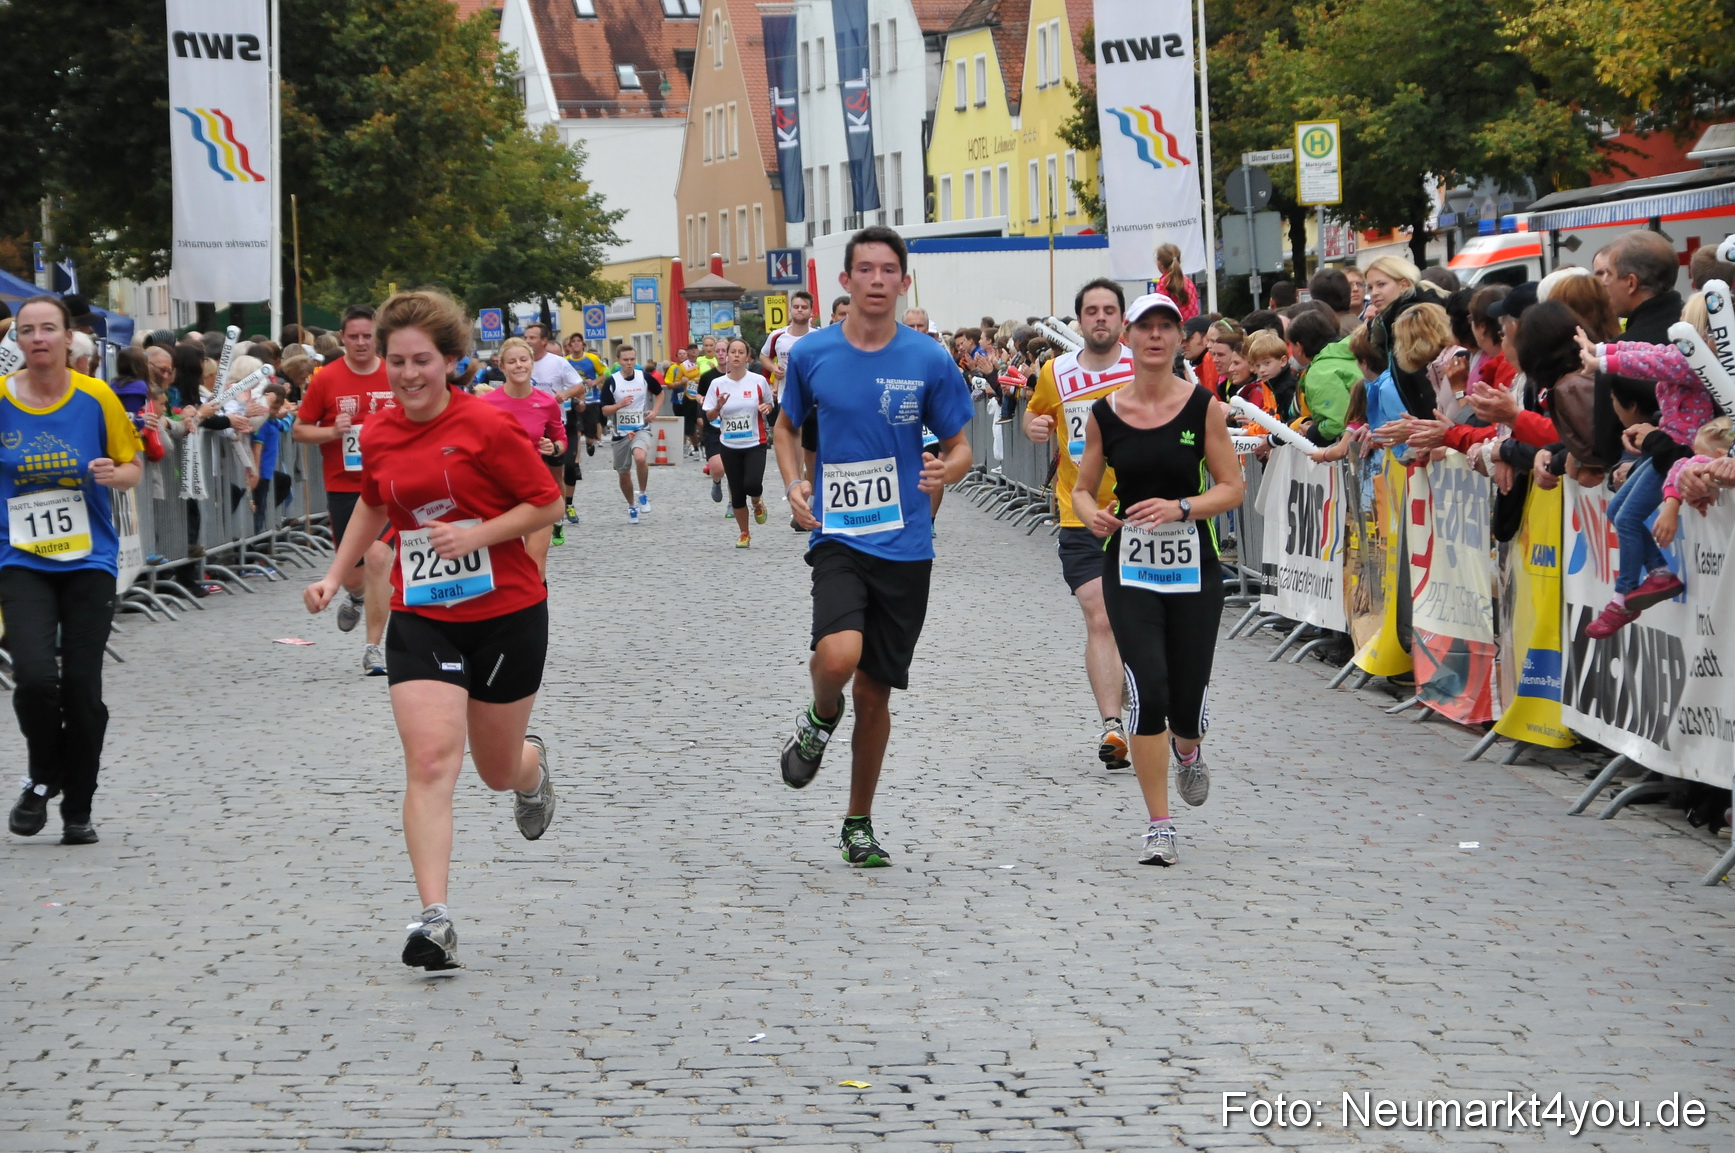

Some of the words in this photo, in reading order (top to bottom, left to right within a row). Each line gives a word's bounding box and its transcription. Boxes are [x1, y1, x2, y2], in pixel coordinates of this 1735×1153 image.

[968, 136, 989, 161] HOTEL
[1310, 134, 1325, 152] H
[1251, 154, 1269, 162] Ulmer
[1272, 152, 1290, 160] Gasse
[766, 297, 786, 305] Block
[771, 307, 783, 325] D
[483, 330, 501, 338] TAXI
[586, 328, 605, 336] TAXI
[619, 414, 640, 424] 2551
[726, 420, 749, 432] 2944
[845, 467, 882, 477] Neumarkt
[829, 476, 892, 508] 2670
[9, 503, 31, 512] PARTL
[34, 496, 70, 508] Neumarkt
[426, 503, 445, 516] DEHN
[24, 506, 73, 538] 115
[843, 510, 881, 525] Samuel
[1123, 525, 1147, 535] PARTL
[1147, 529, 1185, 537] Neumarkt
[34, 540, 70, 555] Andrea
[1128, 537, 1192, 565] 2155
[1138, 570, 1182, 582] Manuela
[430, 584, 464, 600] Sarah
